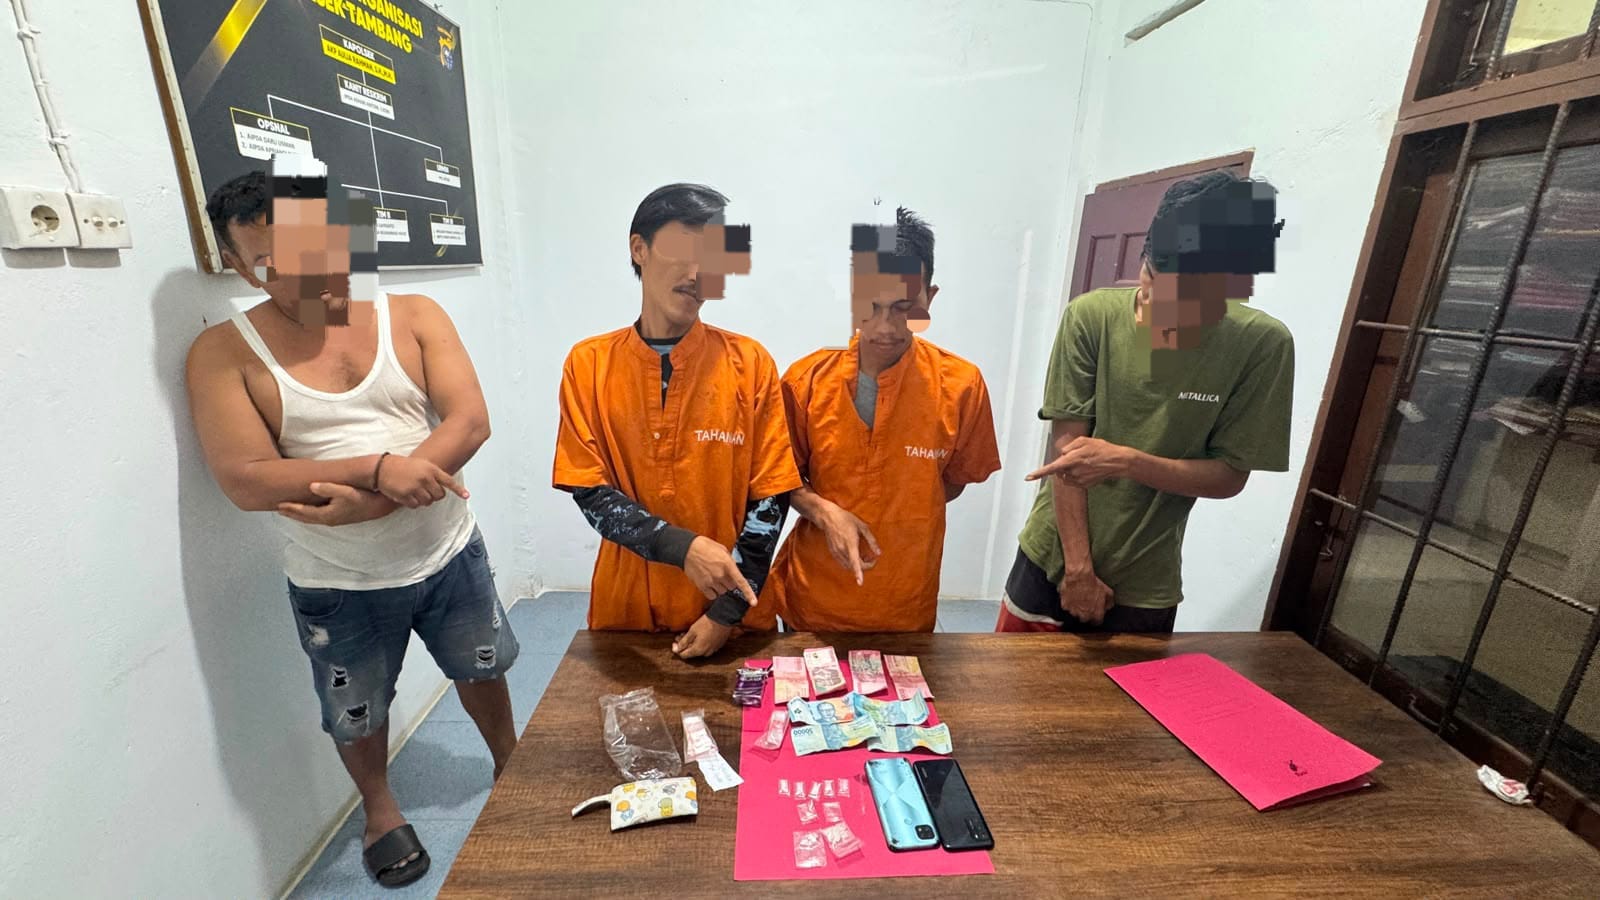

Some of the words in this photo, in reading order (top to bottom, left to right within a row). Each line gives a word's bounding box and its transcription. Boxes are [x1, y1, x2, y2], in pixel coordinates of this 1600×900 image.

[342, 39, 376, 61] KAPOLSEK
[343, 79, 362, 95] KANIT
[257, 118, 291, 135] OPSNAL
